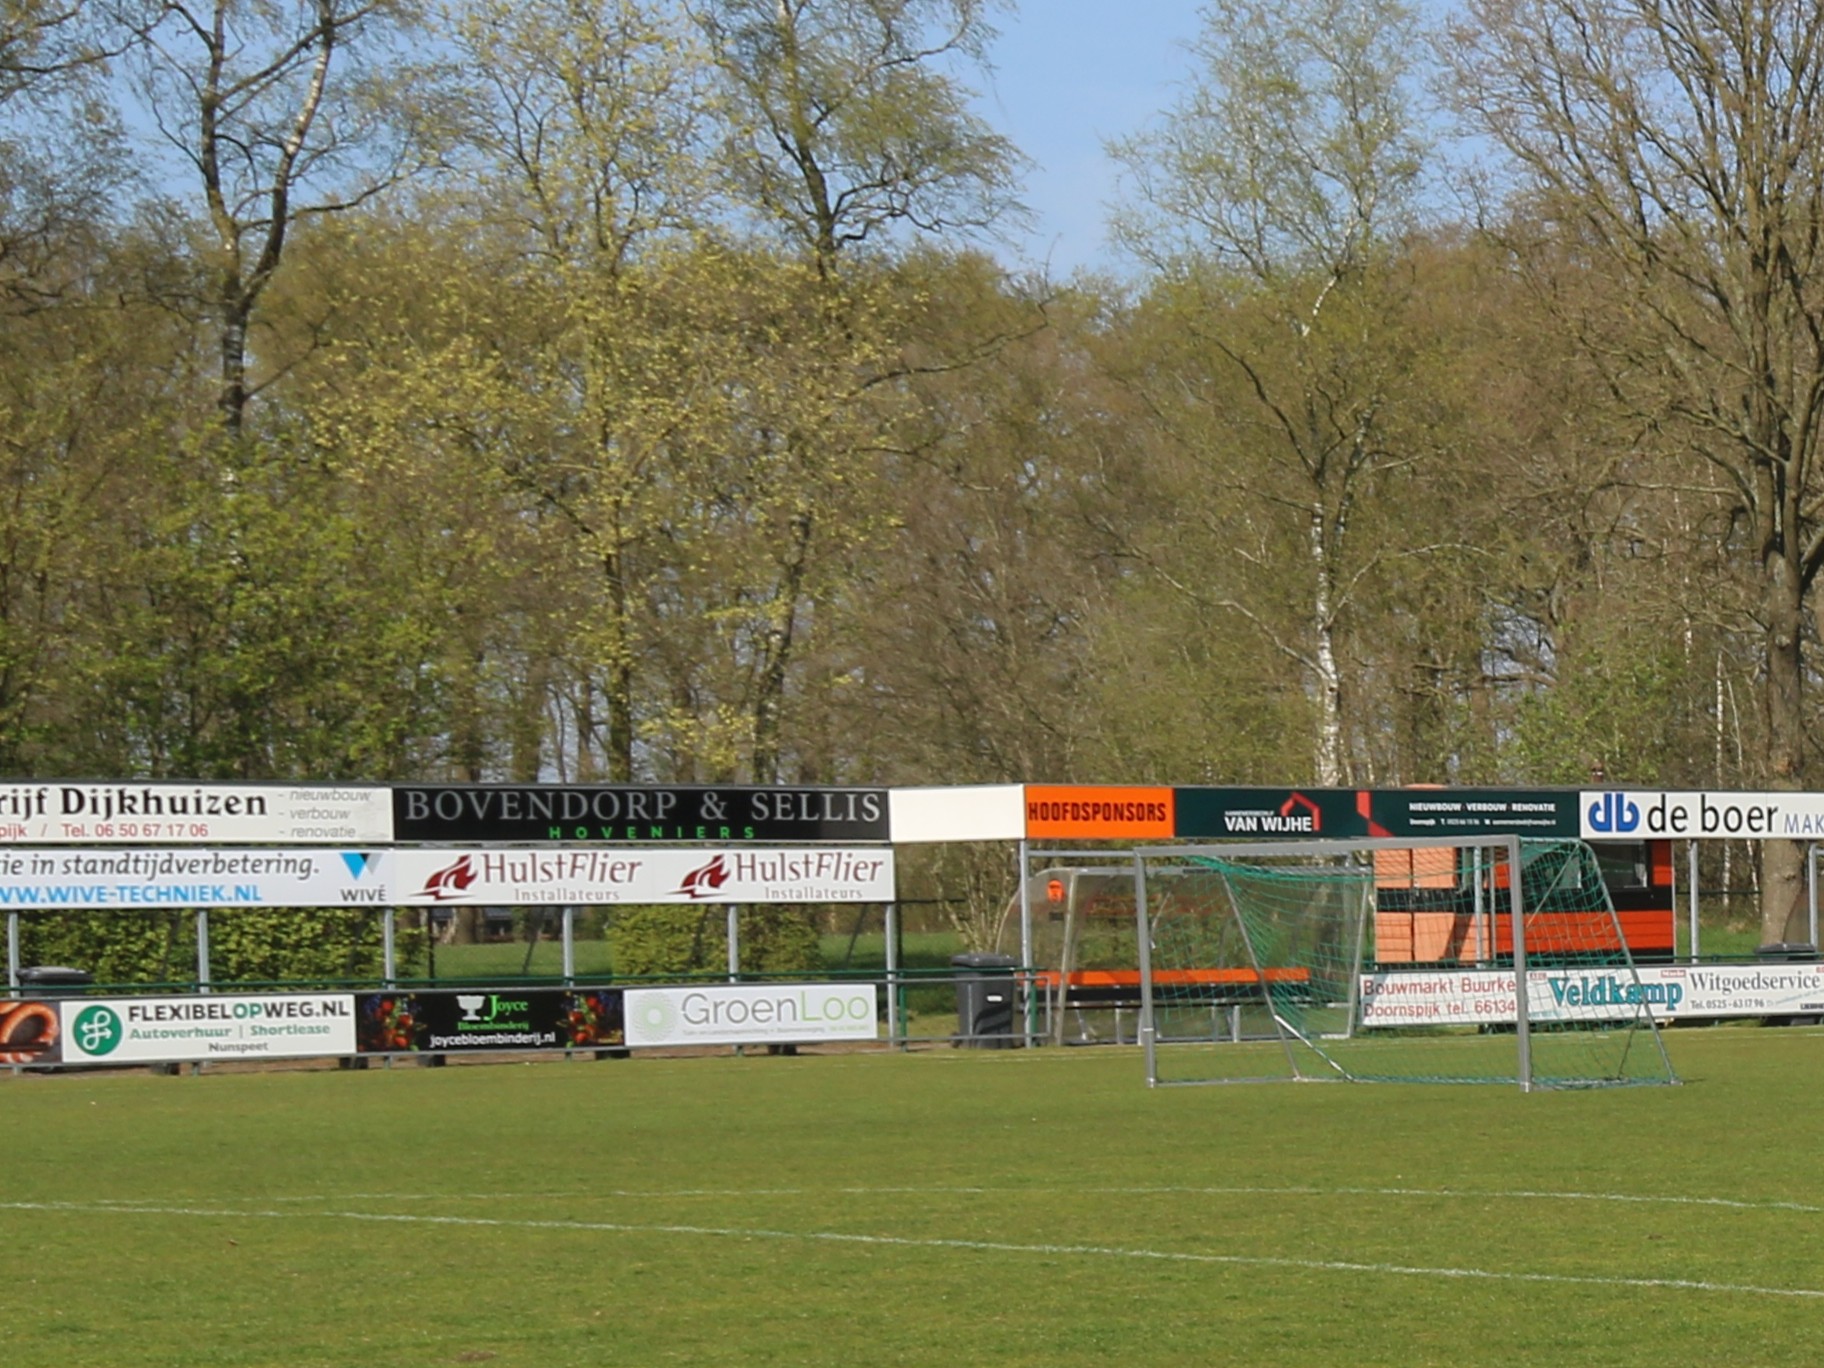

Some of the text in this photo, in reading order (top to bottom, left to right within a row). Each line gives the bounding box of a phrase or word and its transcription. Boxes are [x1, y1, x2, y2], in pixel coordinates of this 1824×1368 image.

[60, 787, 267, 821] Dijkhuizen
[290, 789, 372, 803] nieuwbouw
[290, 807, 351, 821] verbouw
[404, 790, 881, 823] BOVENDORP & SELLIS
[1028, 801, 1167, 822] HOOFDSPONSORS
[1409, 802, 1556, 812] NIEUWBOUW VERBOUW RENOVATIE
[1647, 793, 1689, 833] de
[1700, 793, 1779, 833] boer
[62, 823, 90, 839] Tel.
[95, 823, 114, 839] 06
[119, 823, 138, 839] 50
[143, 823, 161, 839] 67
[167, 823, 184, 839] 17
[189, 823, 209, 839] 06
[290, 825, 356, 839] renovatie
[549, 826, 755, 840] HOVENIERS
[1224, 817, 1313, 832] VAN WIJHE
[32, 852, 319, 881] in standtijdverbetering.
[481, 852, 643, 884] HulstFlier
[733, 851, 884, 883] HulstFlier
[340, 885, 387, 902] WIVÉ
[514, 887, 621, 902] Installateurs
[764, 886, 863, 900] Installateurs
[1363, 977, 1454, 999] Bouwmarkt
[1690, 969, 1821, 995] Witgoedservice
[1547, 975, 1683, 1012] Veldkamp
[128, 1000, 350, 1023] FLEXIBELOPWEG.NL
[483, 994, 529, 1022] Joyce
[681, 990, 870, 1026] GroenLoo
[1363, 1001, 1440, 1021] Doornspijk
[1690, 999, 1705, 1010] Tel.
[1706, 998, 1727, 1010] 0525
[129, 1022, 331, 1041] Autoverhuur Shortlease
[429, 1030, 556, 1049] joycebloembinderij.nl
[207, 1041, 269, 1055] Nunspeet
